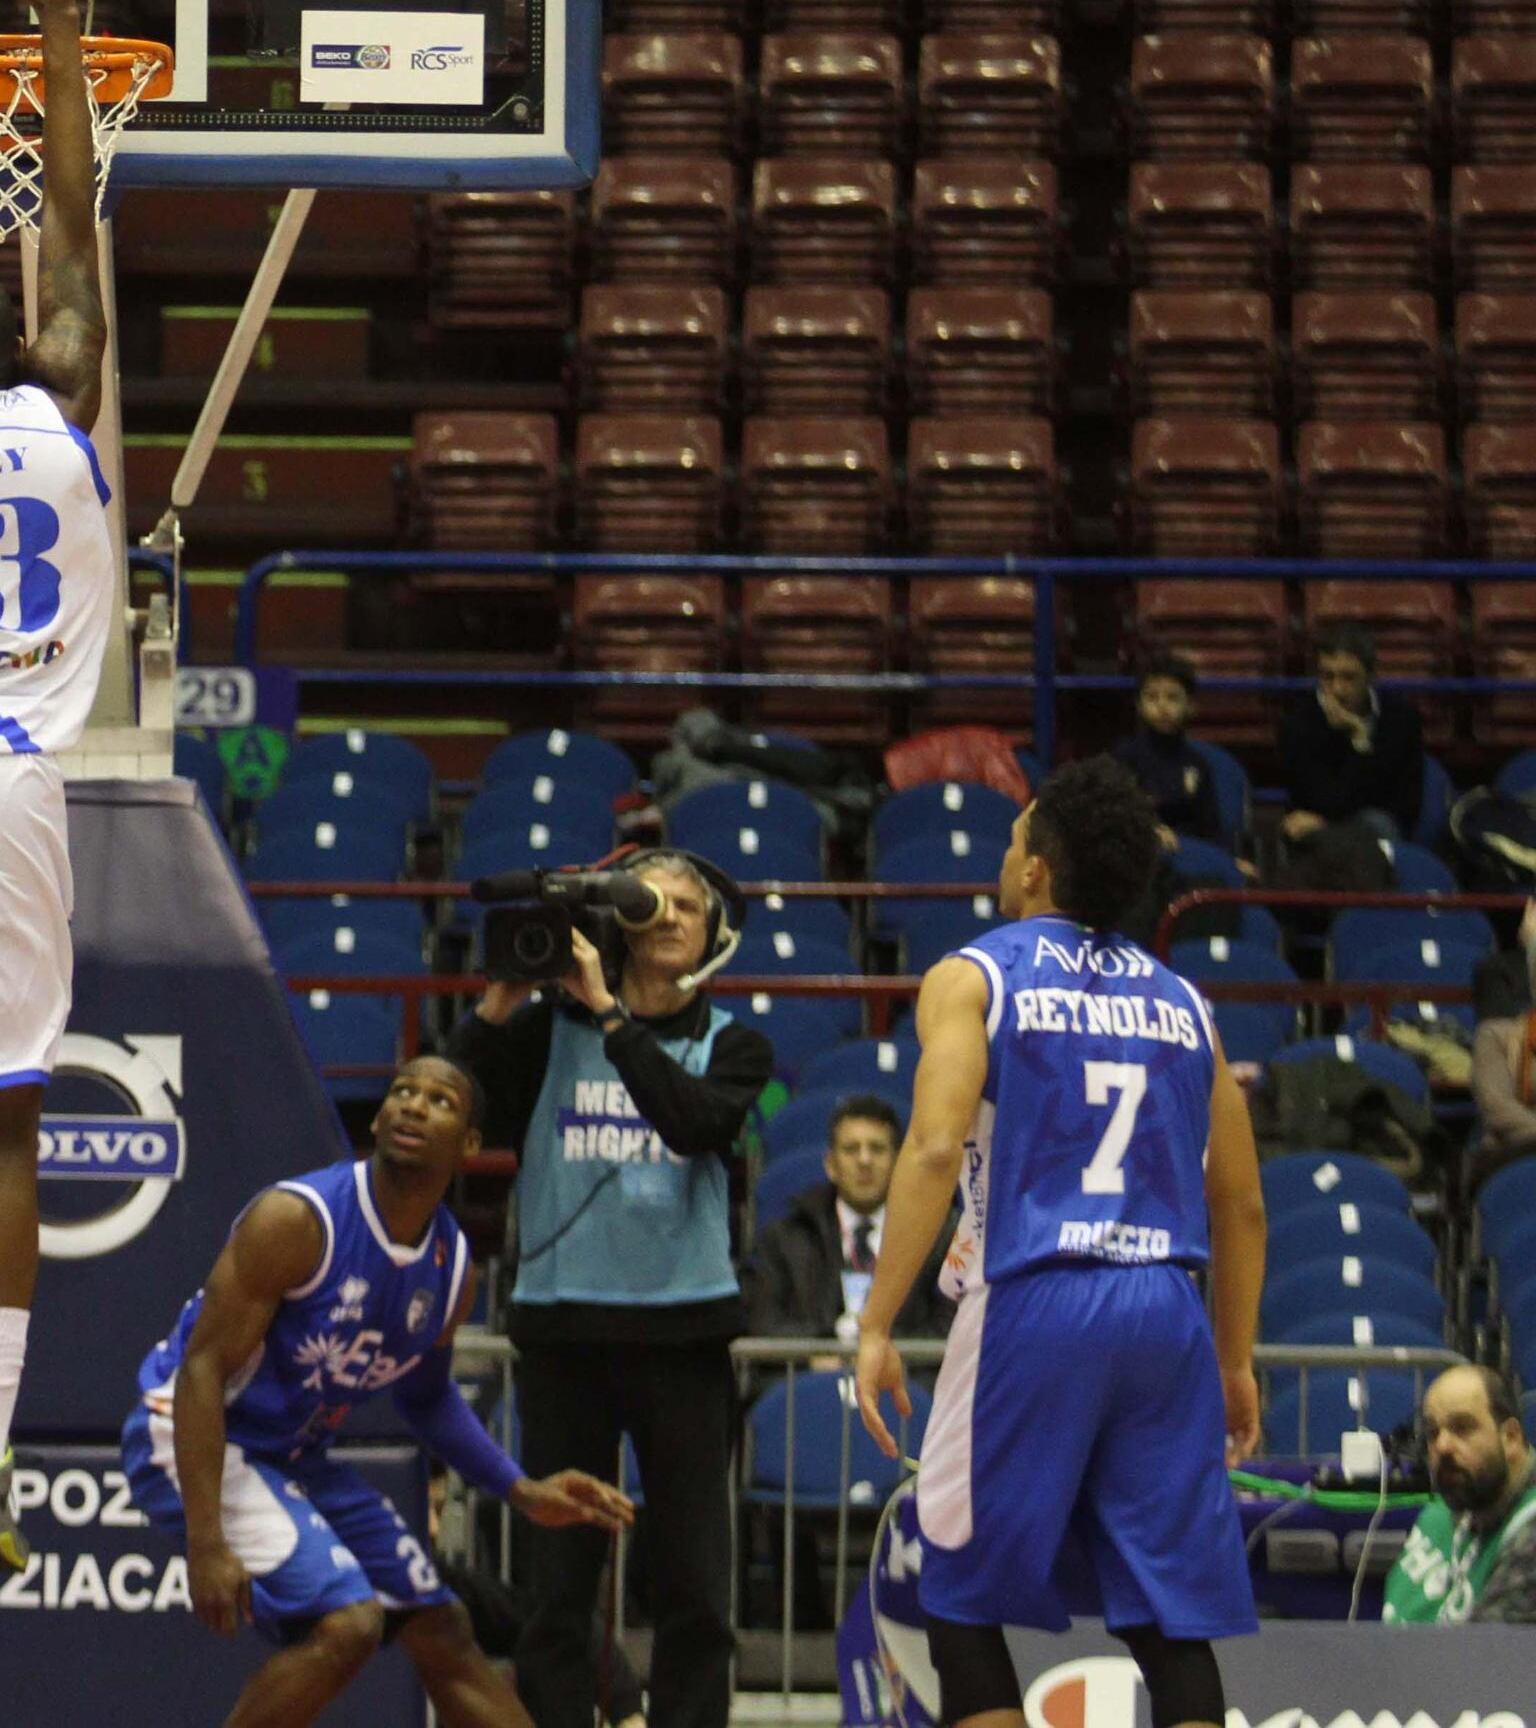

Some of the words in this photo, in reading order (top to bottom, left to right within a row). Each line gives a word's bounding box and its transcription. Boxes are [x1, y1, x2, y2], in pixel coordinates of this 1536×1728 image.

[315, 51, 352, 61] BEKO
[411, 51, 448, 71] RCS
[448, 53, 474, 69] Sport
[179, 675, 241, 716] 29
[1013, 986, 1199, 1051] REYNOLDS
[1080, 1059, 1148, 1195] 7
[37, 1131, 168, 1164] LVO
